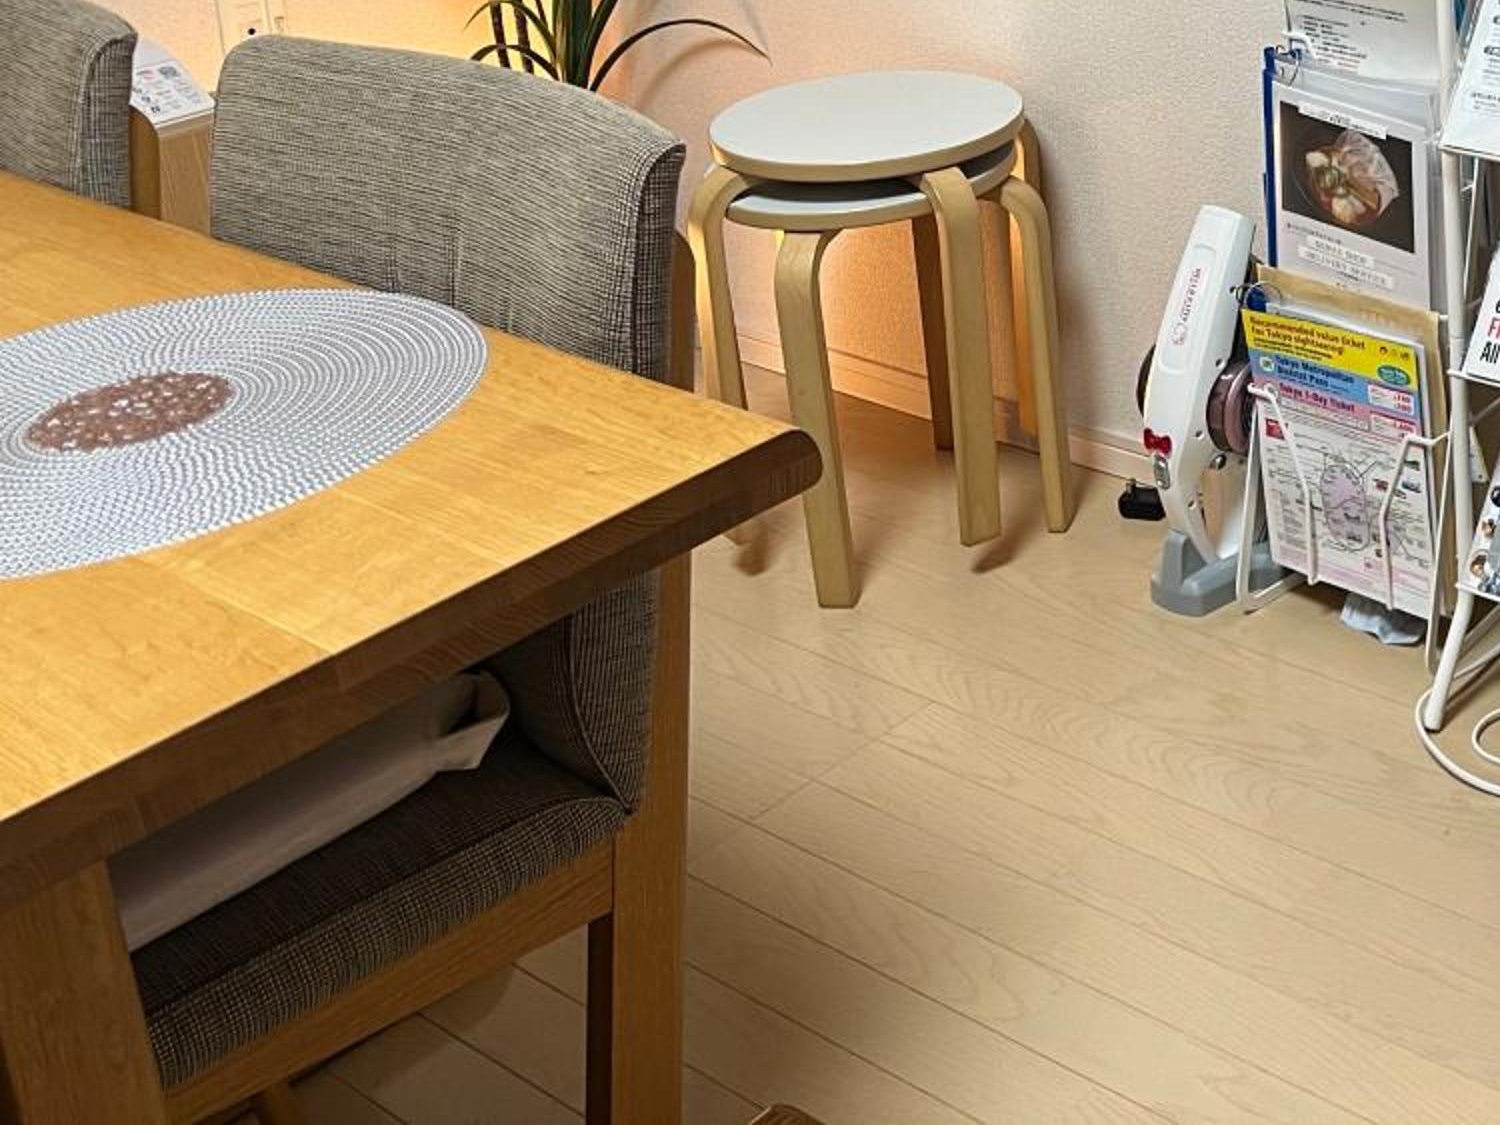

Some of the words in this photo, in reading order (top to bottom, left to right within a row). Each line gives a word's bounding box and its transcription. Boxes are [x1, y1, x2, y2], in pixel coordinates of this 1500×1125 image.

[1267, 328, 1293, 343] Tokyo
[1480, 342, 1499, 364] All
[1280, 382, 1304, 397] Tokyo
